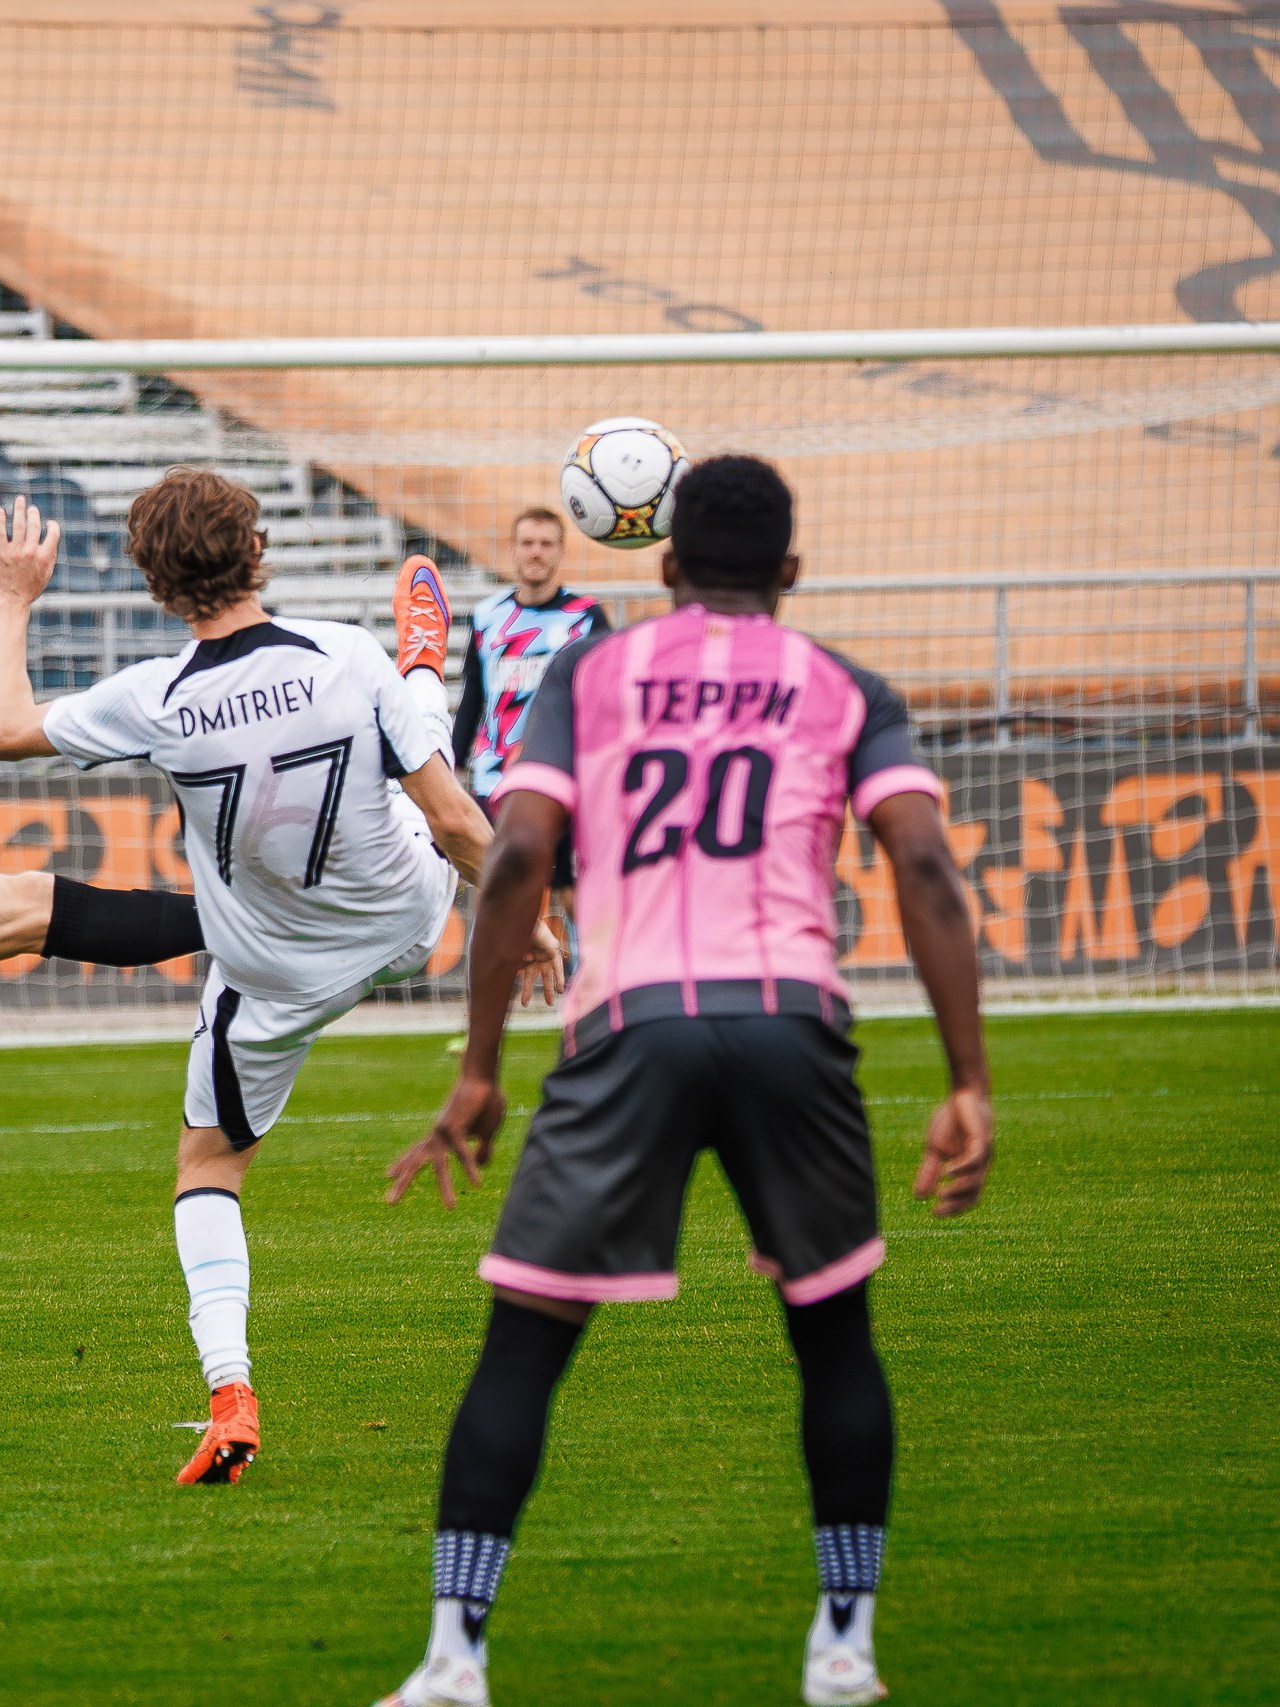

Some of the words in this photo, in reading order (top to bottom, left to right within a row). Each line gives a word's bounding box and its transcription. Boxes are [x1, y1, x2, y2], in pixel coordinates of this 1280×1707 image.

[178, 676, 313, 738] DMITRIEV
[171, 735, 354, 890] 77
[623, 745, 773, 876] 20
